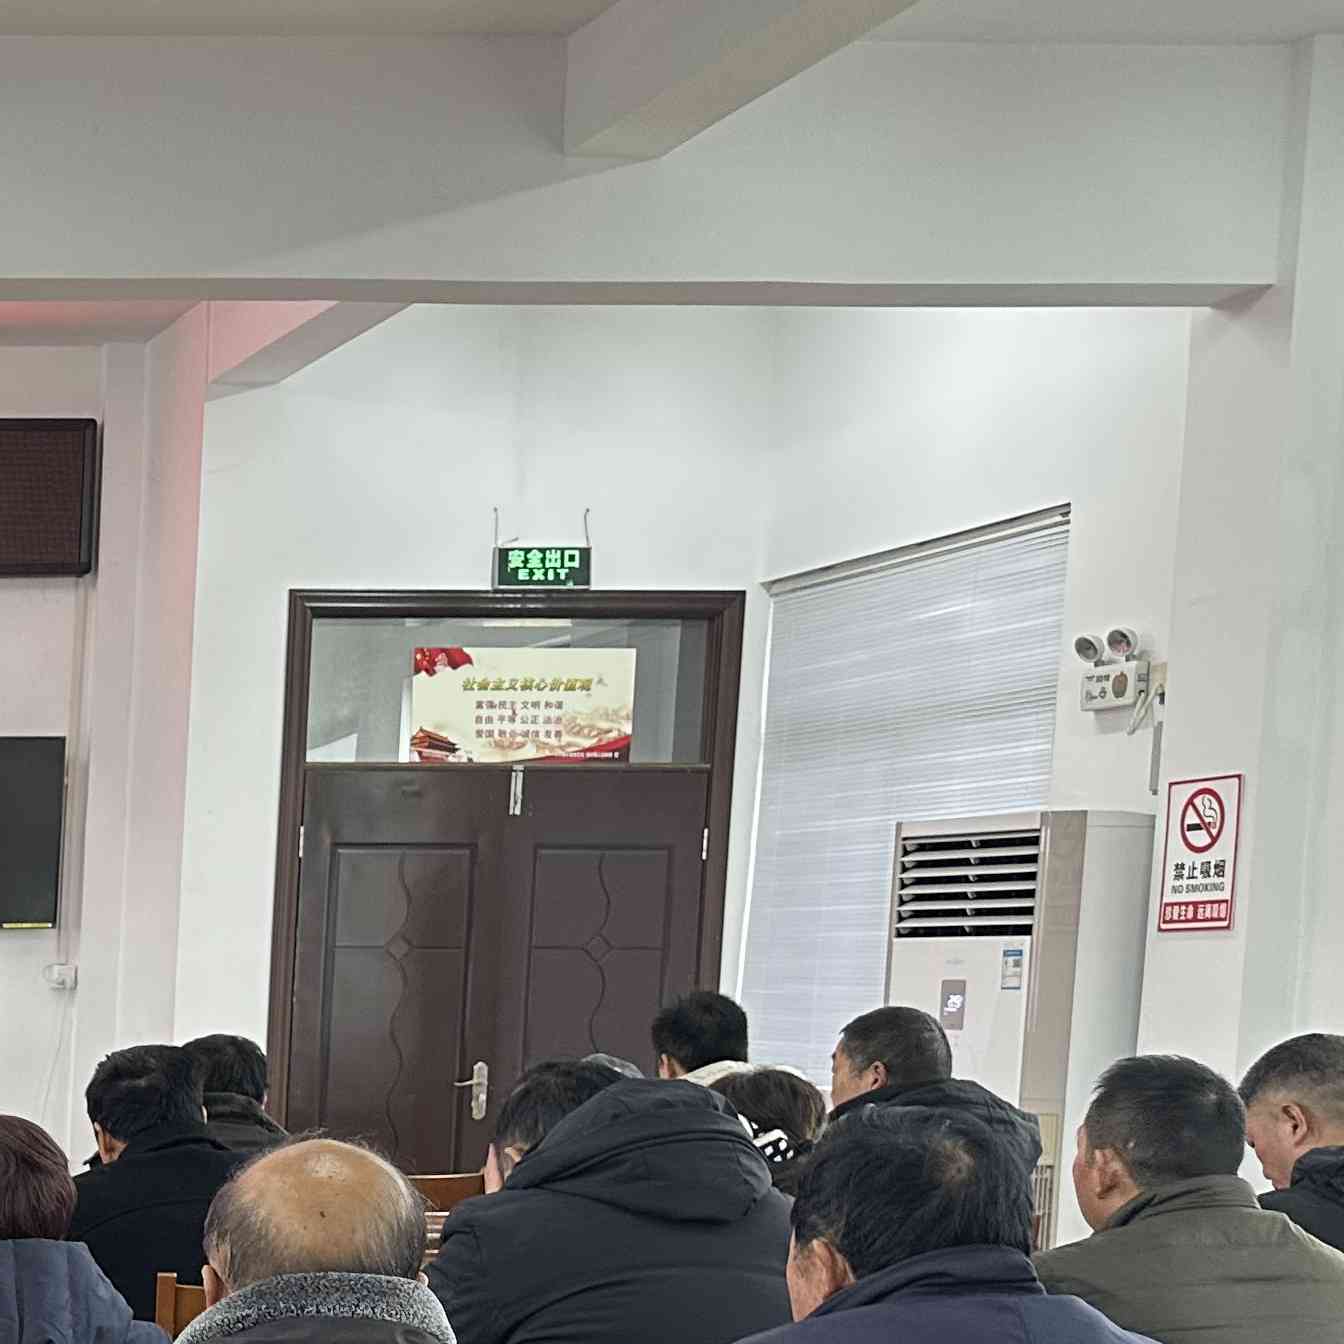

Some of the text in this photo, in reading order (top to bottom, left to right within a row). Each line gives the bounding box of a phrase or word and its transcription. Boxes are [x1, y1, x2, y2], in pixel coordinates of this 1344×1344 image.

[508, 549, 580, 568] 安全出口
[517, 569, 569, 580] EXIT
[462, 677, 593, 691] 社会主义核心价值观
[1172, 859, 1226, 881] 禁止吸烟
[1171, 882, 1225, 894] NO SMOKING
